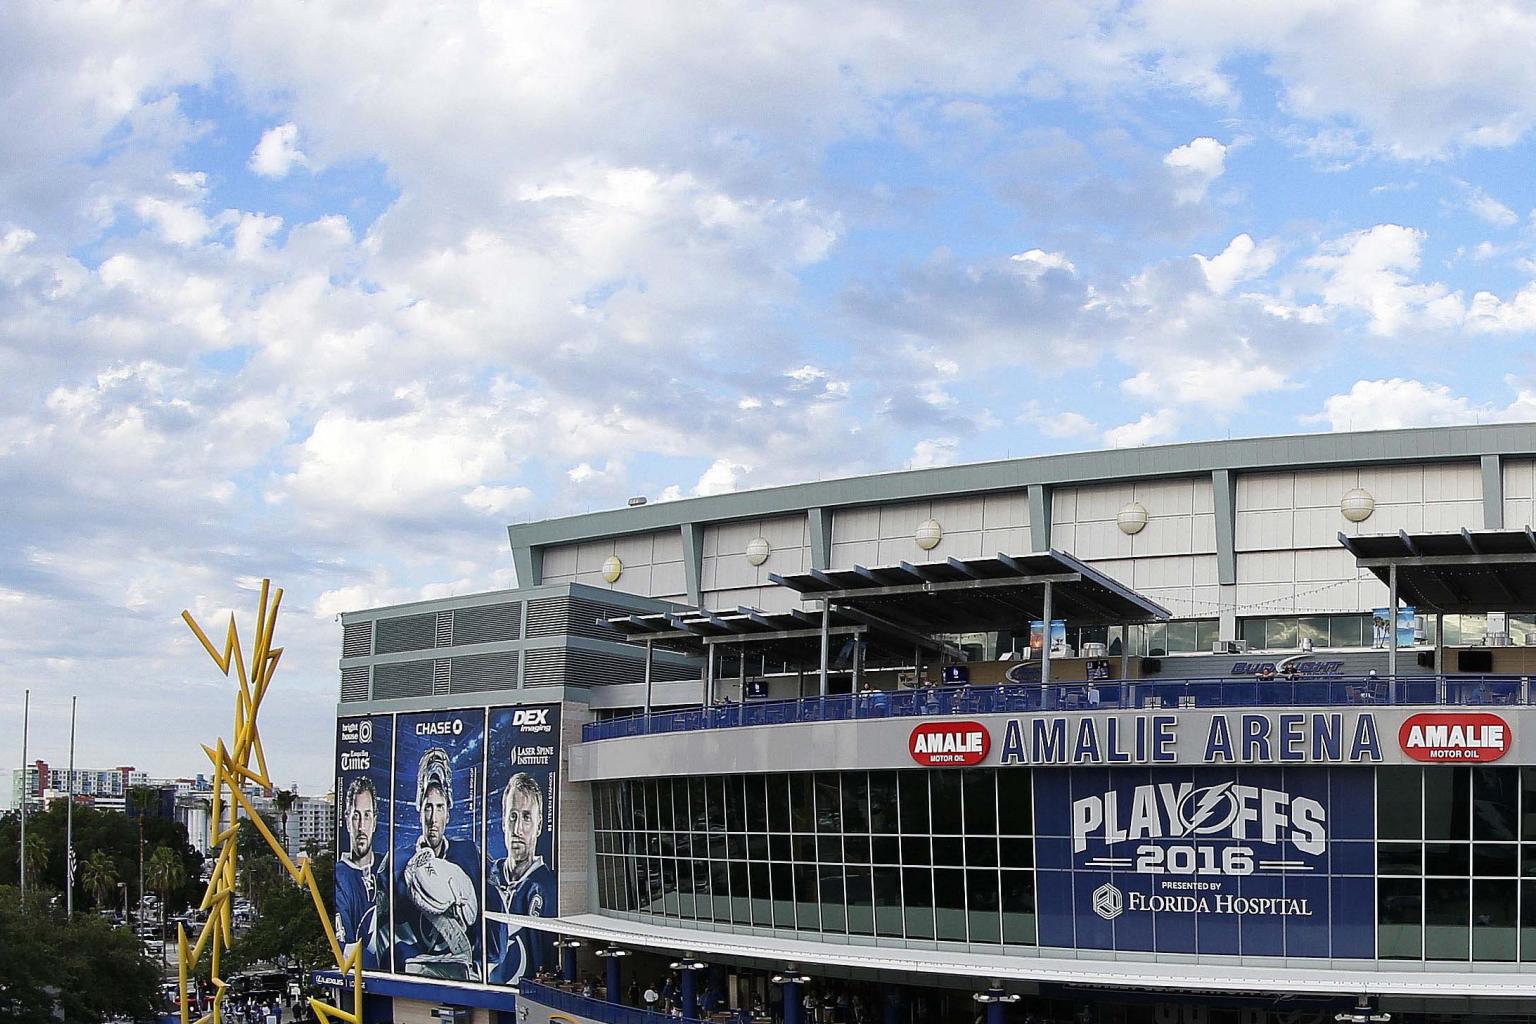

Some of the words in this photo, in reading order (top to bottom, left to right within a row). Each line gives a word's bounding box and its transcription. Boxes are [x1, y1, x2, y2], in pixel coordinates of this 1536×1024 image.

[1281, 661, 1344, 673] IGHT
[512, 709, 549, 726] DEX
[342, 723, 359, 733] bright
[342, 732, 359, 741] house
[416, 721, 451, 735] CHASE
[1406, 725, 1504, 748] AMALIE
[914, 732, 983, 753] AMALIE
[999, 715, 1178, 765] AMALIE
[1202, 712, 1383, 762] ARENA
[341, 753, 370, 770] Times
[1430, 750, 1462, 759] MOTOR
[1464, 750, 1479, 758] OIL
[1073, 781, 1326, 856] PLAYOFFS
[1136, 845, 1255, 875] 2016
[1162, 881, 1209, 890] PRESENTED
[1210, 882, 1222, 890] BY
[1128, 892, 1211, 913] FLORIDA
[1214, 894, 1313, 916] HOSPITAL
